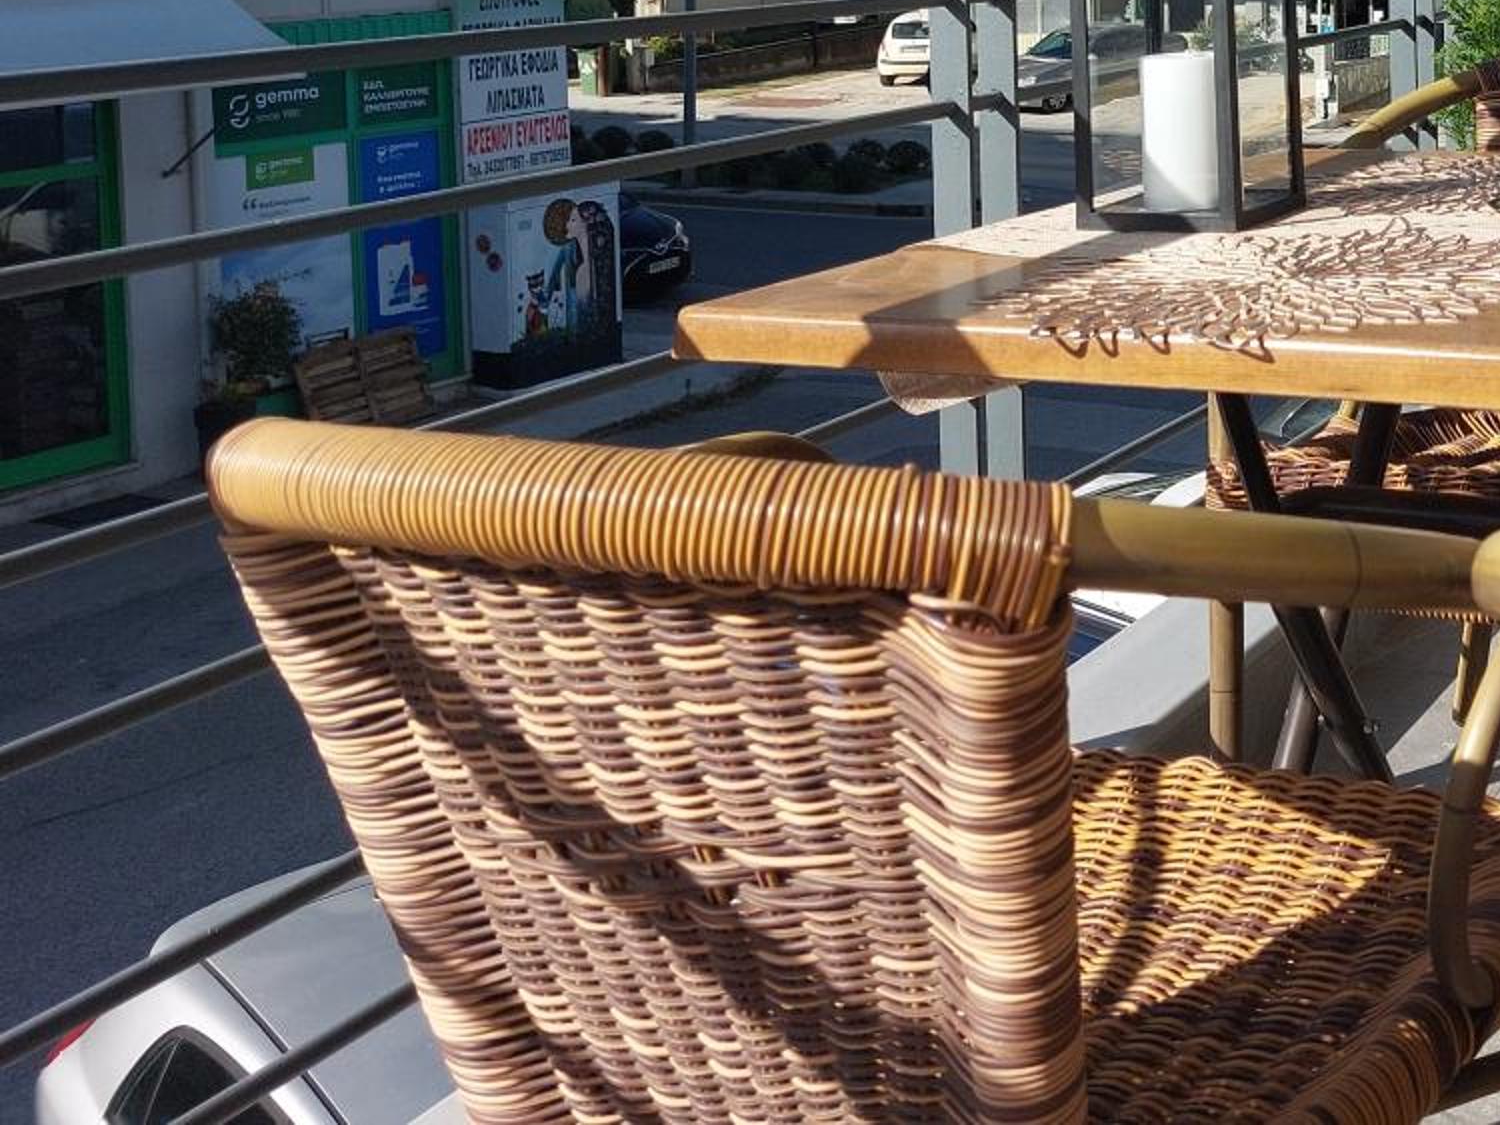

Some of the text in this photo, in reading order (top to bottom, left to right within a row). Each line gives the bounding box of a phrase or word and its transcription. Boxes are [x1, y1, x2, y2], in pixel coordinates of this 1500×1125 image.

[469, 49, 559, 82] ΓΕΩΡΓΙΚΑ ΕΦΟΔΙΑ
[255, 86, 319, 109] gemma
[486, 84, 545, 114] ΛΙΠΑΣΜΑΤΑ
